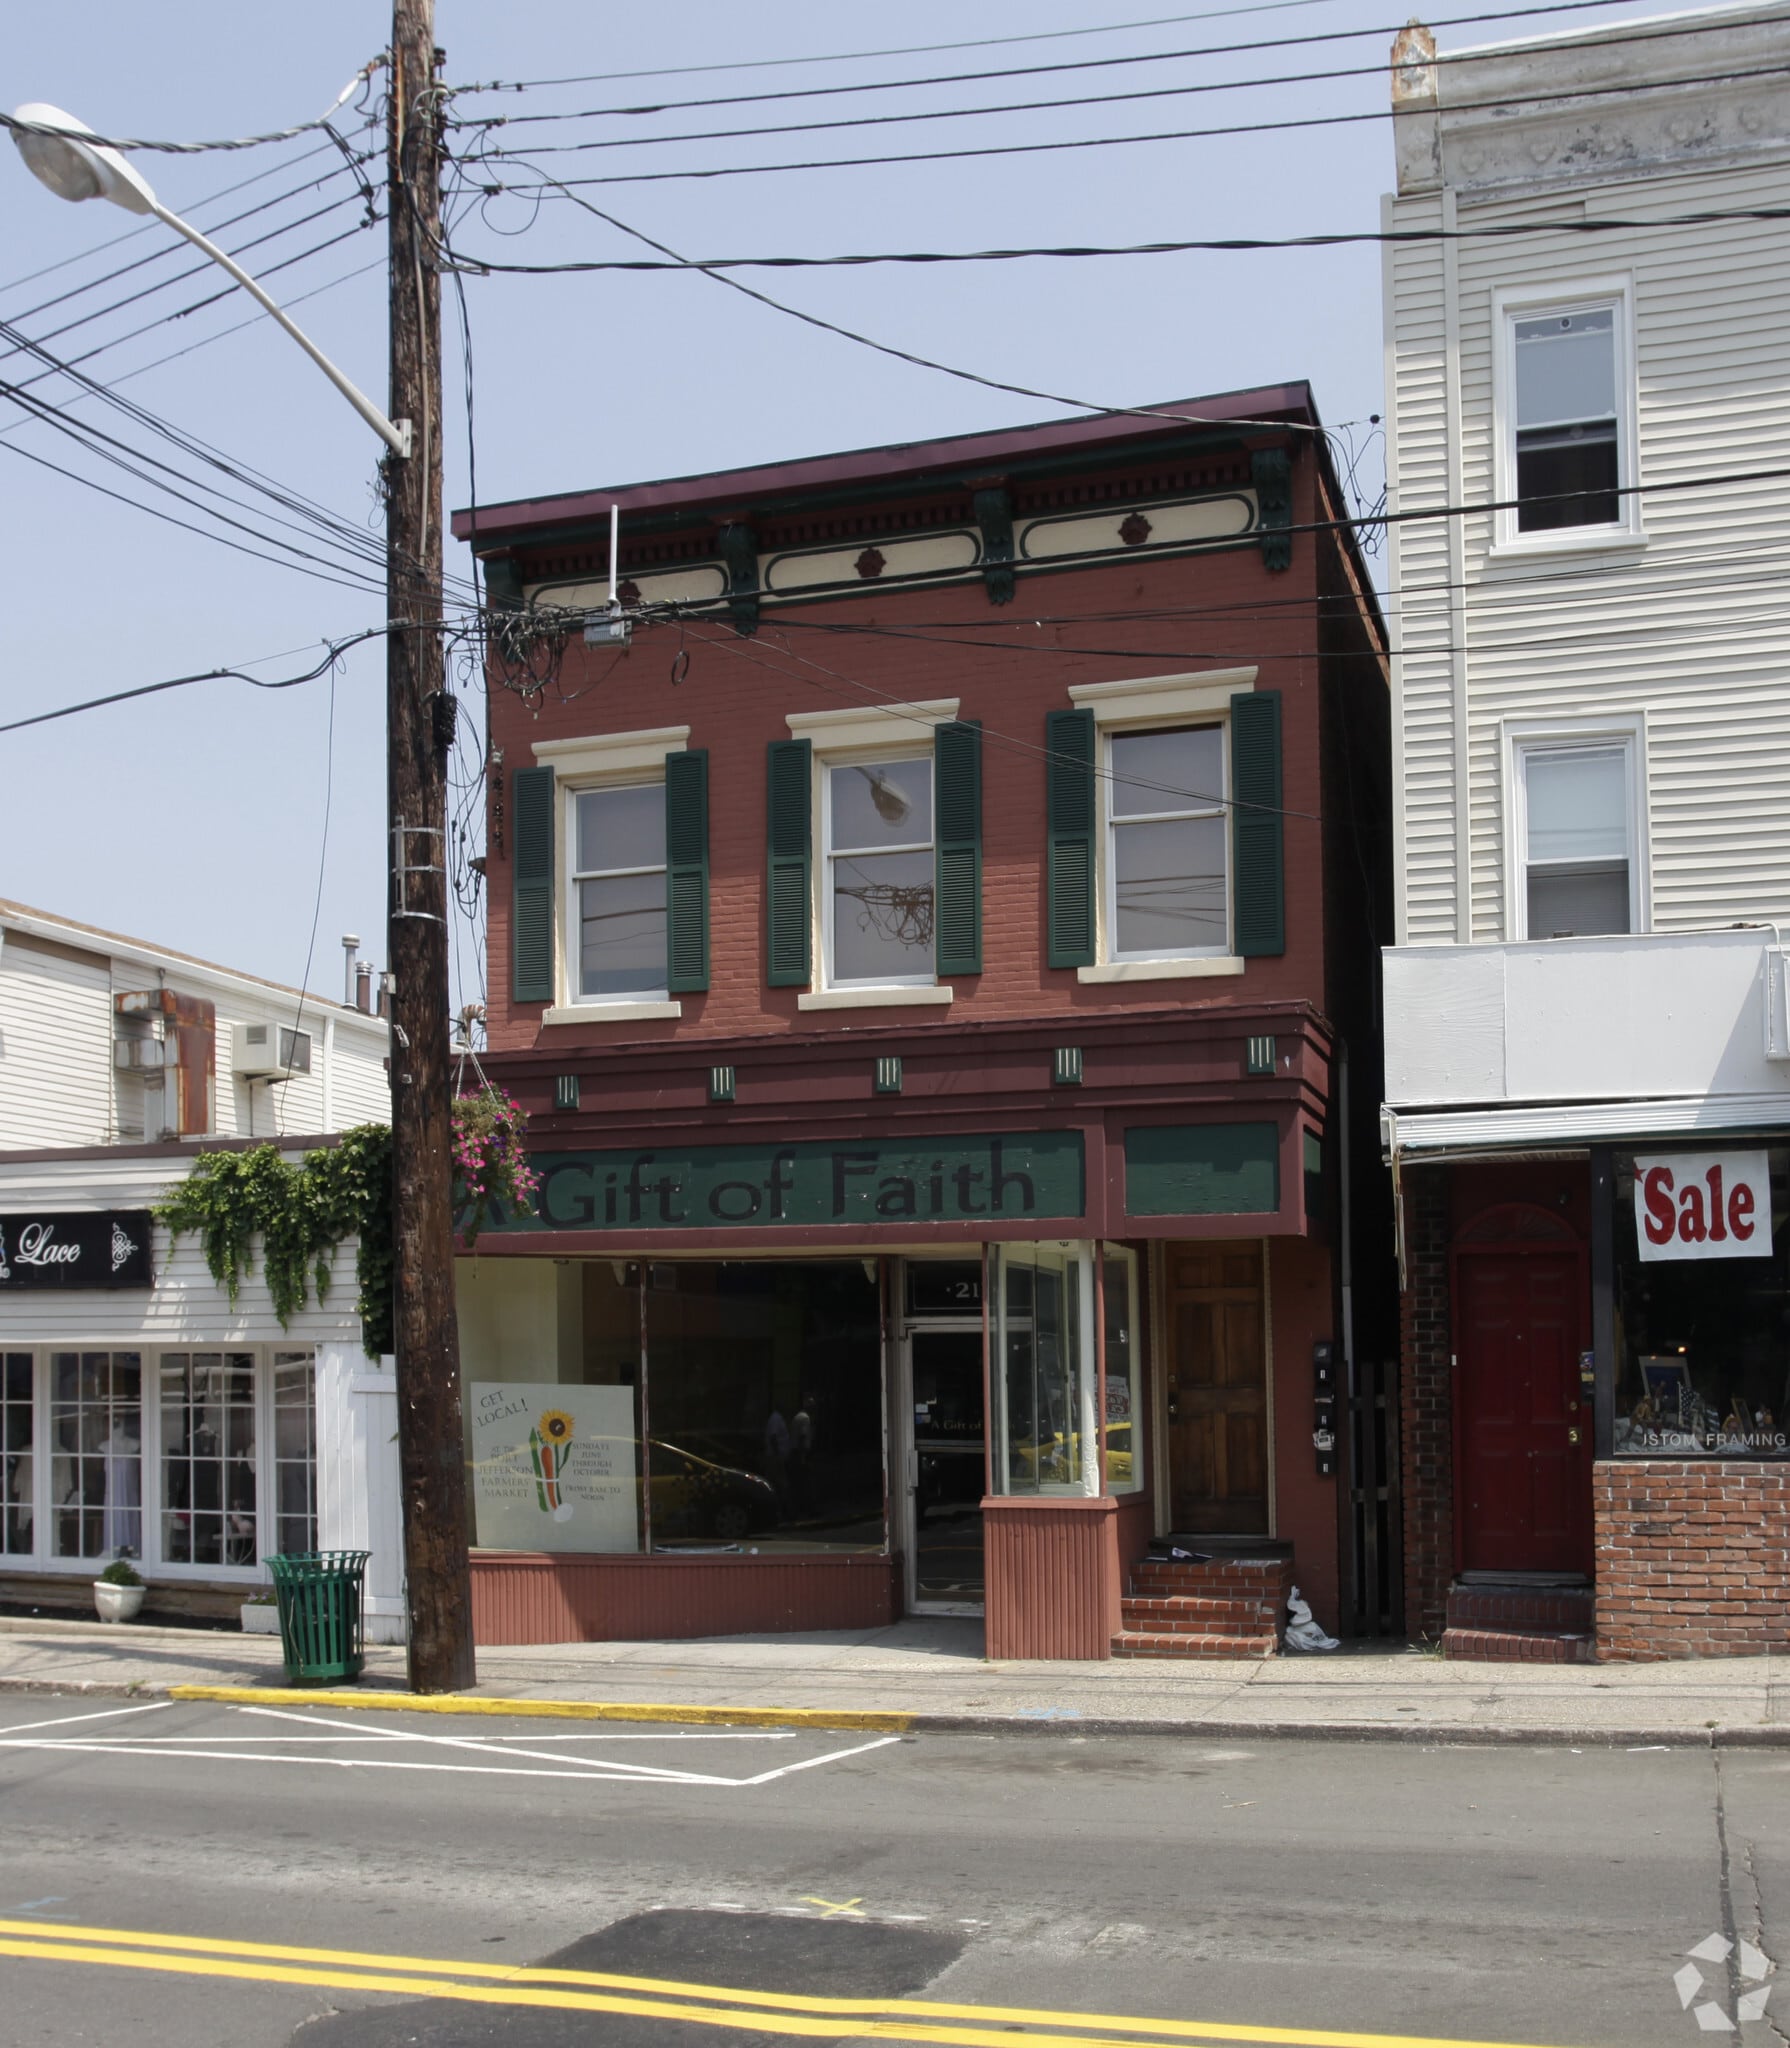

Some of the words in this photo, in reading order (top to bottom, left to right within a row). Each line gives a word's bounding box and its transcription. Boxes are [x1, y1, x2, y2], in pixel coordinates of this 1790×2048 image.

[535, 1153, 687, 1228] Gift
[708, 1150, 797, 1221] of
[831, 1139, 1035, 1219] Faith
[1644, 1164, 1755, 1245] Sale
[14, 1223, 81, 1266] Lace
[477, 1397, 529, 1428] LOCAL!
[480, 1390, 504, 1408] GET
[1706, 1432, 1787, 1447] FRAMING
[483, 1488, 529, 1498] MARKET
